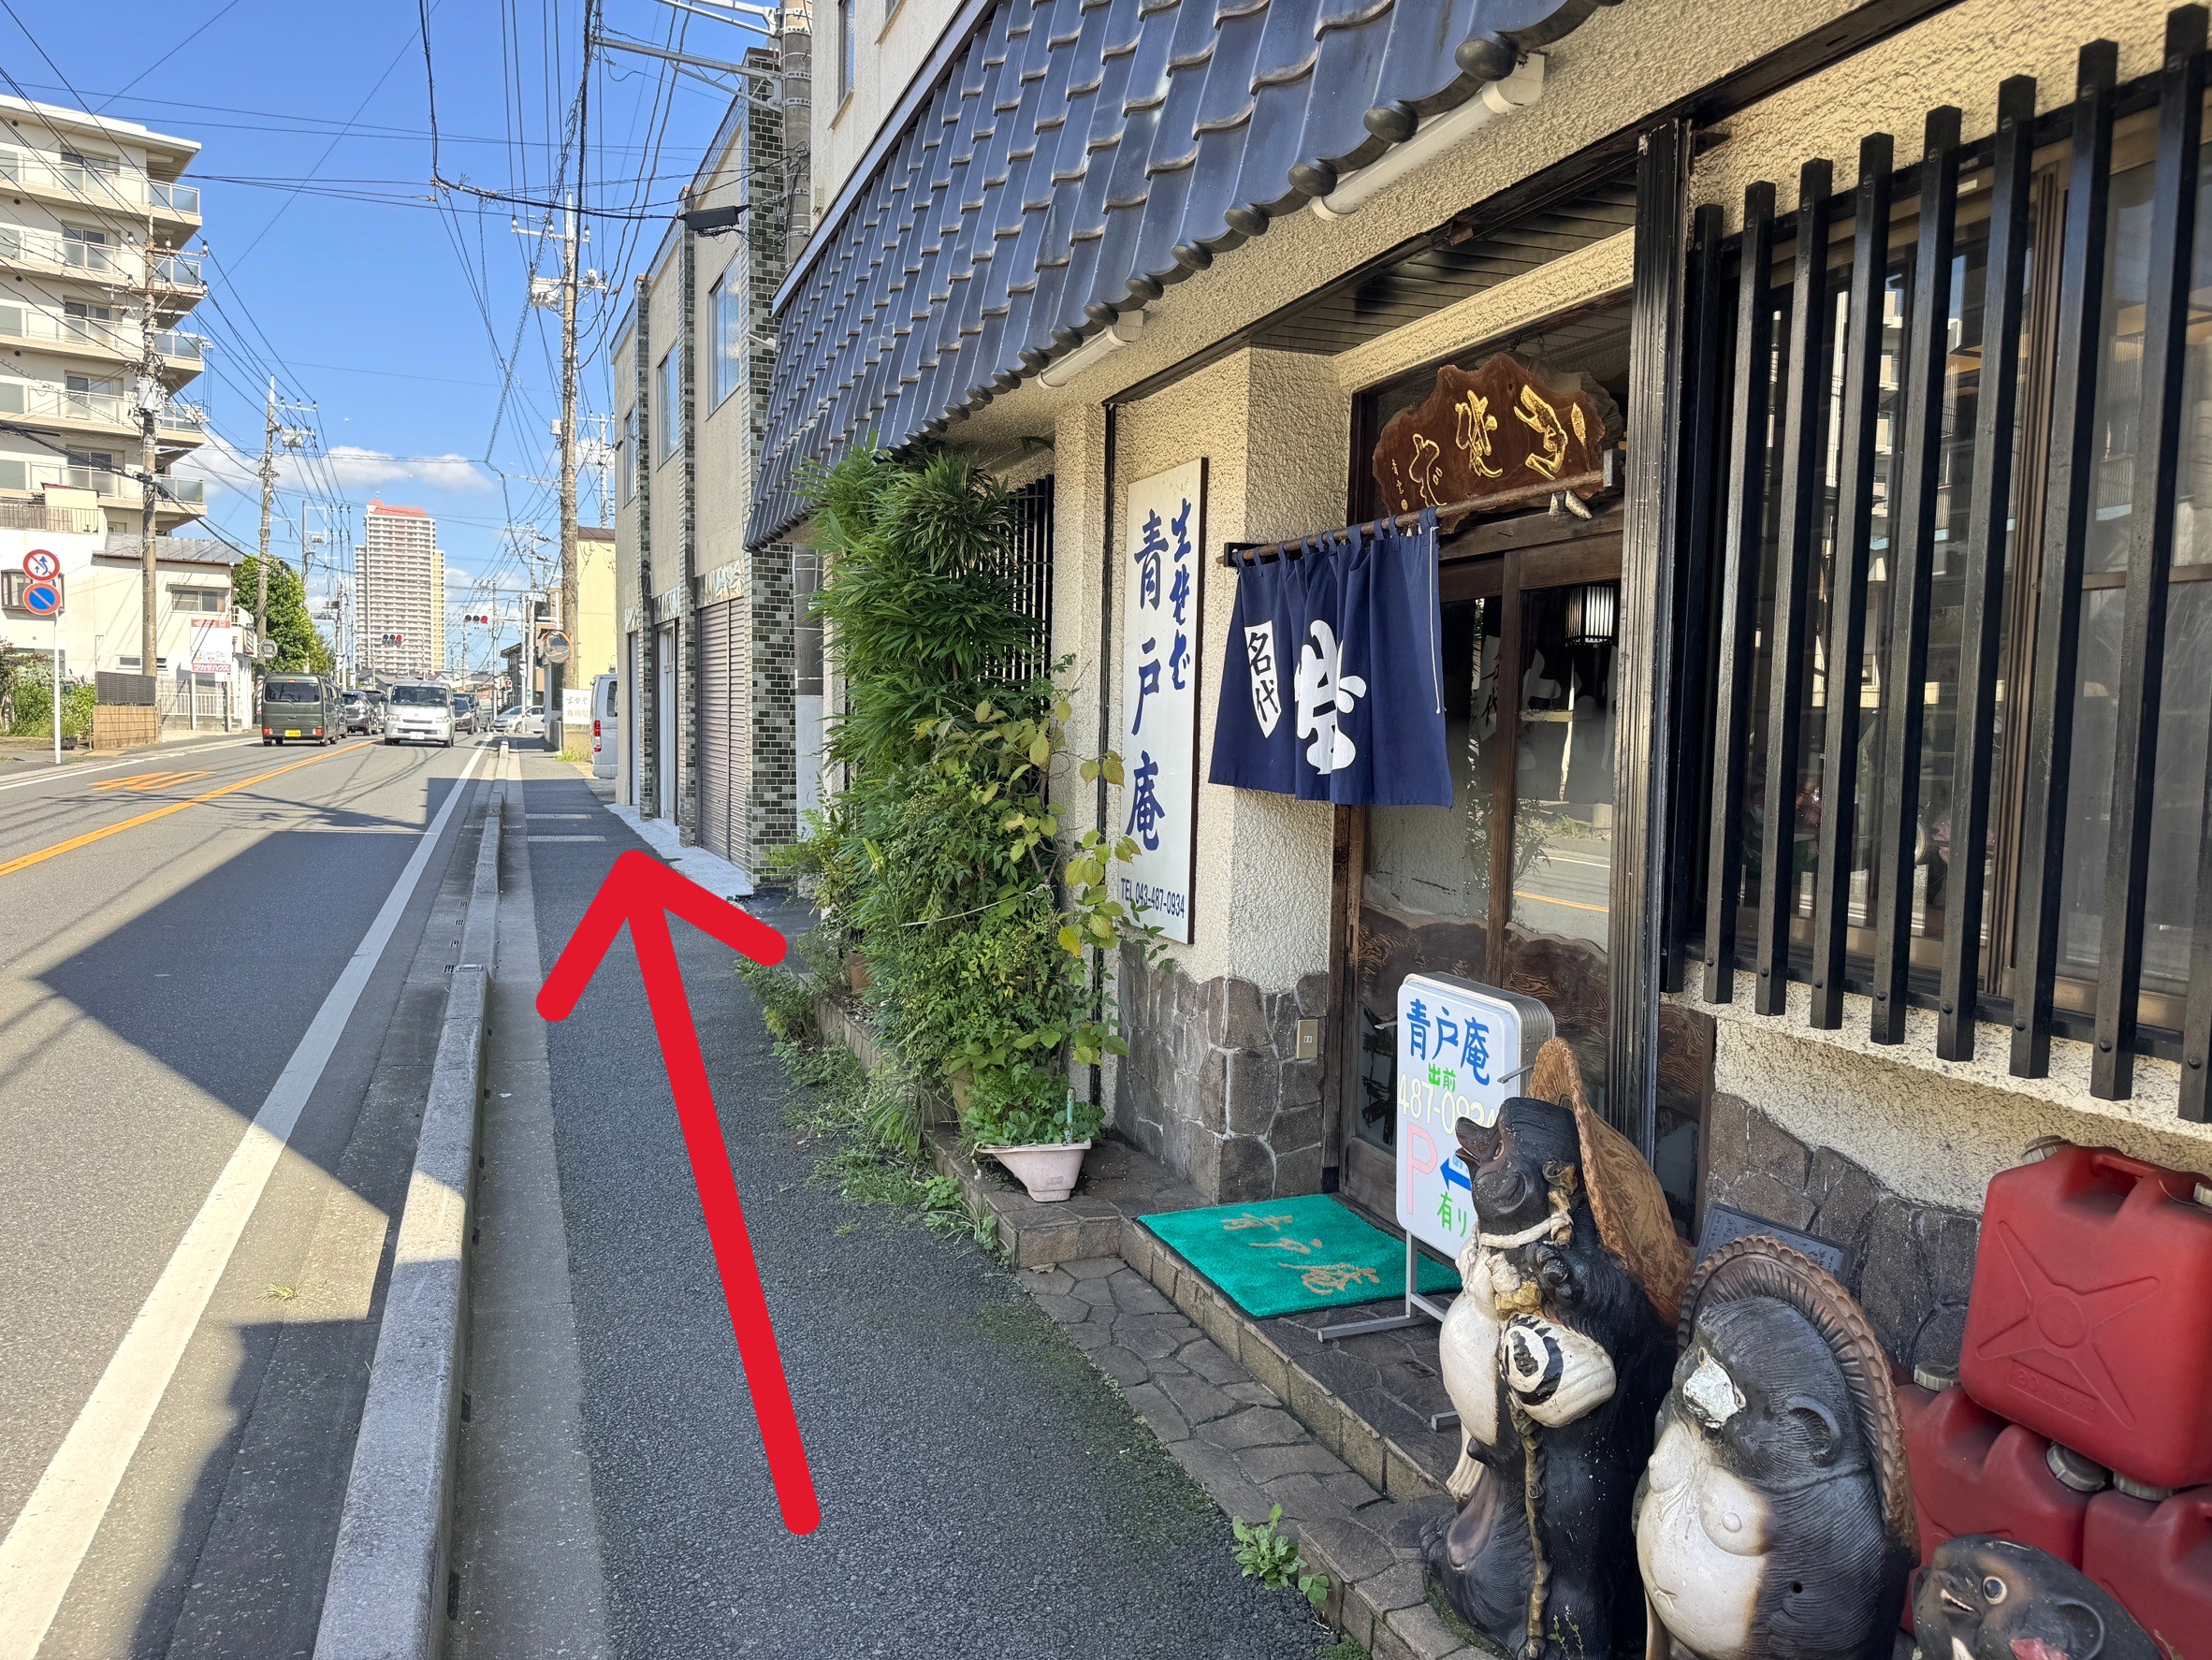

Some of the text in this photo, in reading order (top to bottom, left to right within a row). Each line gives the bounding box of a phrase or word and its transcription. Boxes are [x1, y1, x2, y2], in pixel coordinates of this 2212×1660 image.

[194, 663, 229, 672] ツカサハウス
[1126, 508, 1169, 851] 青戸庵
[1248, 633, 1279, 722] 名代
[1121, 878, 1185, 918] TEL 043-487-0934
[1406, 998, 1490, 1085] 青戸庵
[1428, 1063, 1456, 1092] 出前
[1407, 1122, 1438, 1215] P
[1437, 1192, 1467, 1238] 有り
